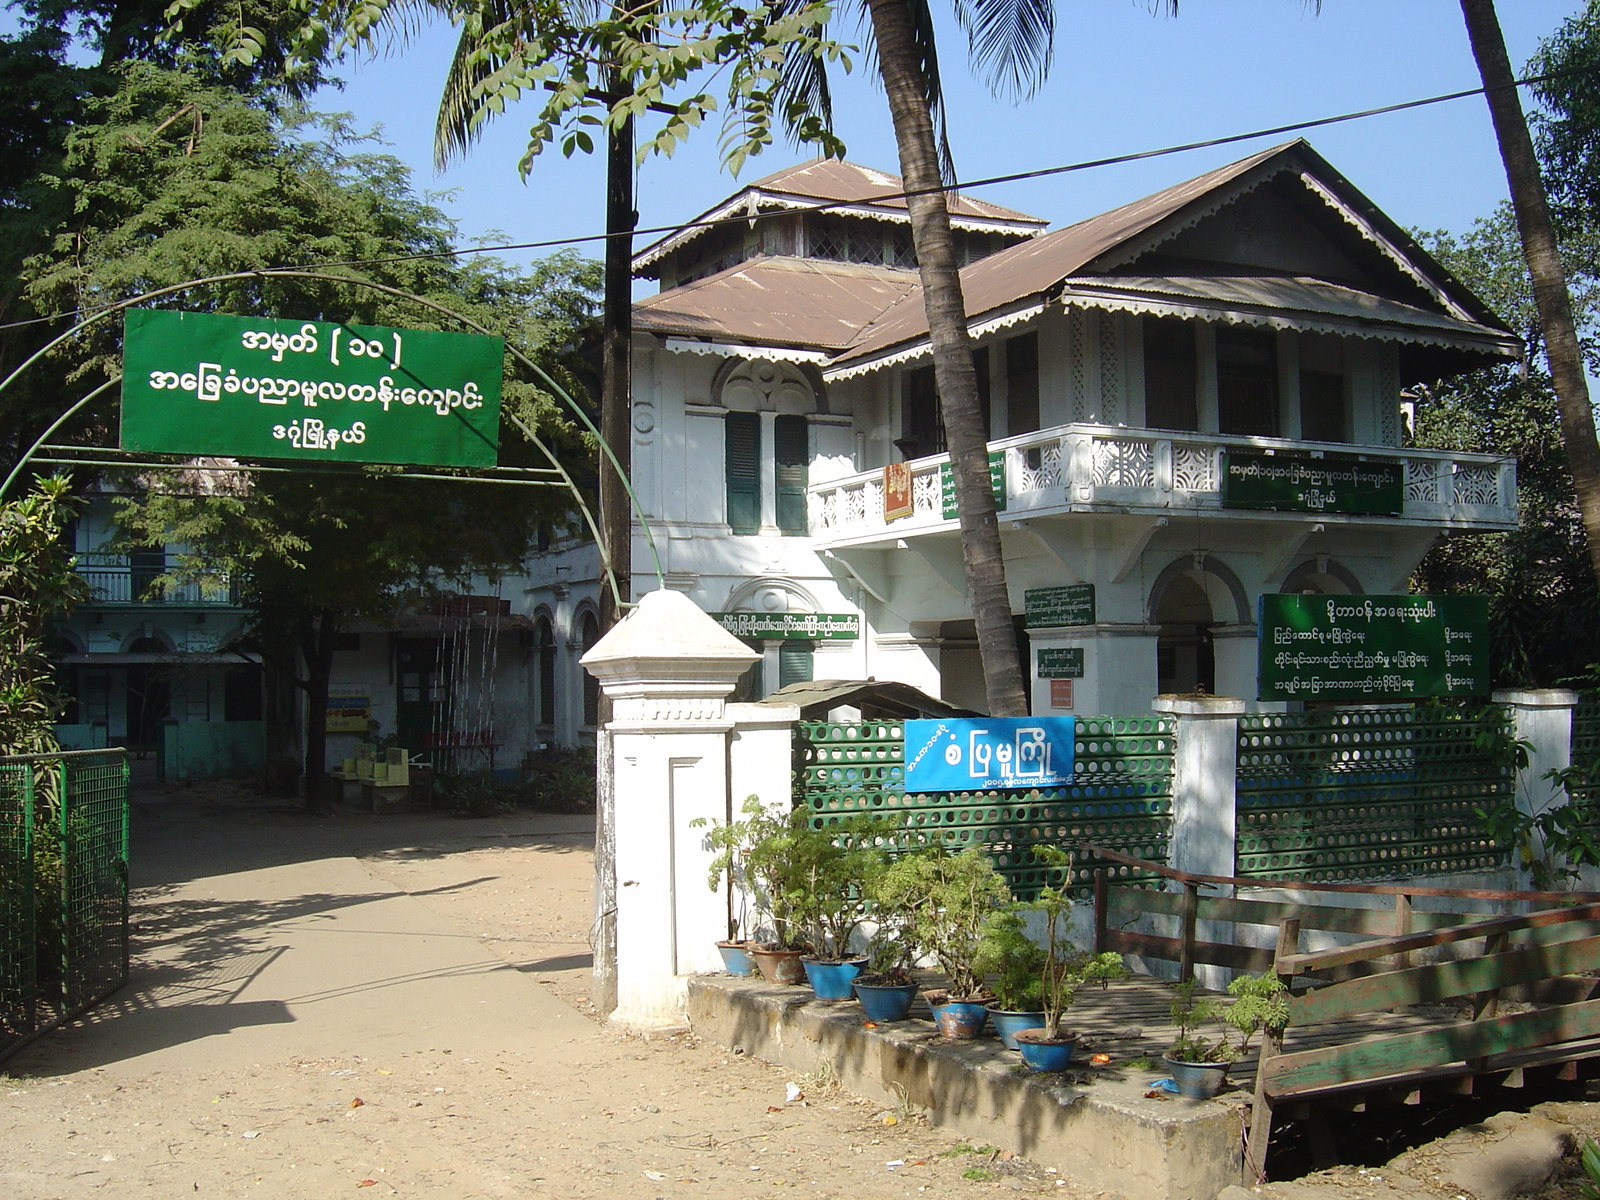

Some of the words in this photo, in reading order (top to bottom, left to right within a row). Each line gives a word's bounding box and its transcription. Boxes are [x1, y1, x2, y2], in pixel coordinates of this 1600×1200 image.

[242, 324, 318, 362] အမှတ်
[149, 362, 483, 416] အခြေခံပညာမူလတန်းကျောင်း
[272, 418, 366, 450] ဒဂုံမြို့နယ်
